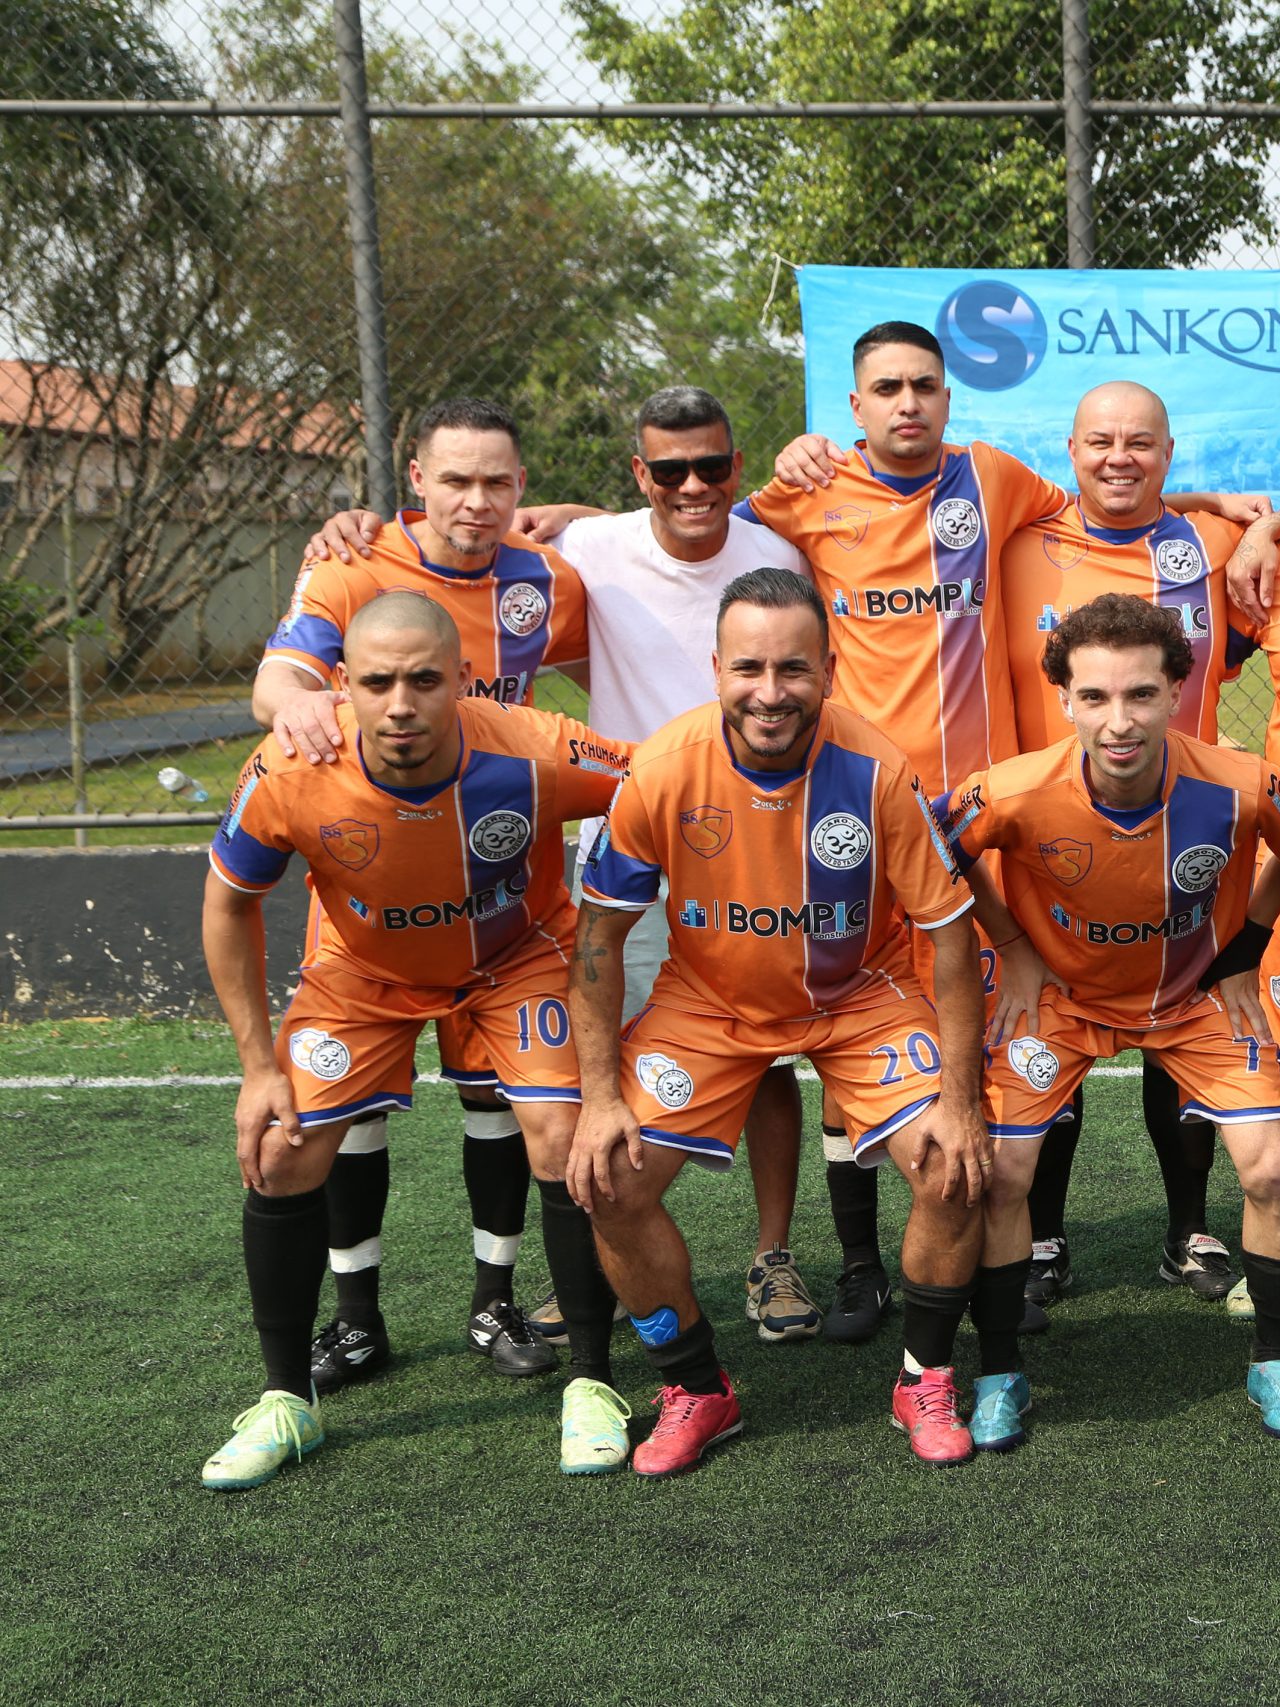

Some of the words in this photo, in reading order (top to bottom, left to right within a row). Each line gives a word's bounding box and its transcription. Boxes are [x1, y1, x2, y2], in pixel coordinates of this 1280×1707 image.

[865, 578, 983, 617] BOMPIC
[383, 869, 527, 931] BOMPIC
[728, 900, 866, 938] BOMPIC
[515, 998, 570, 1053] 10
[869, 1031, 941, 1088] 20
